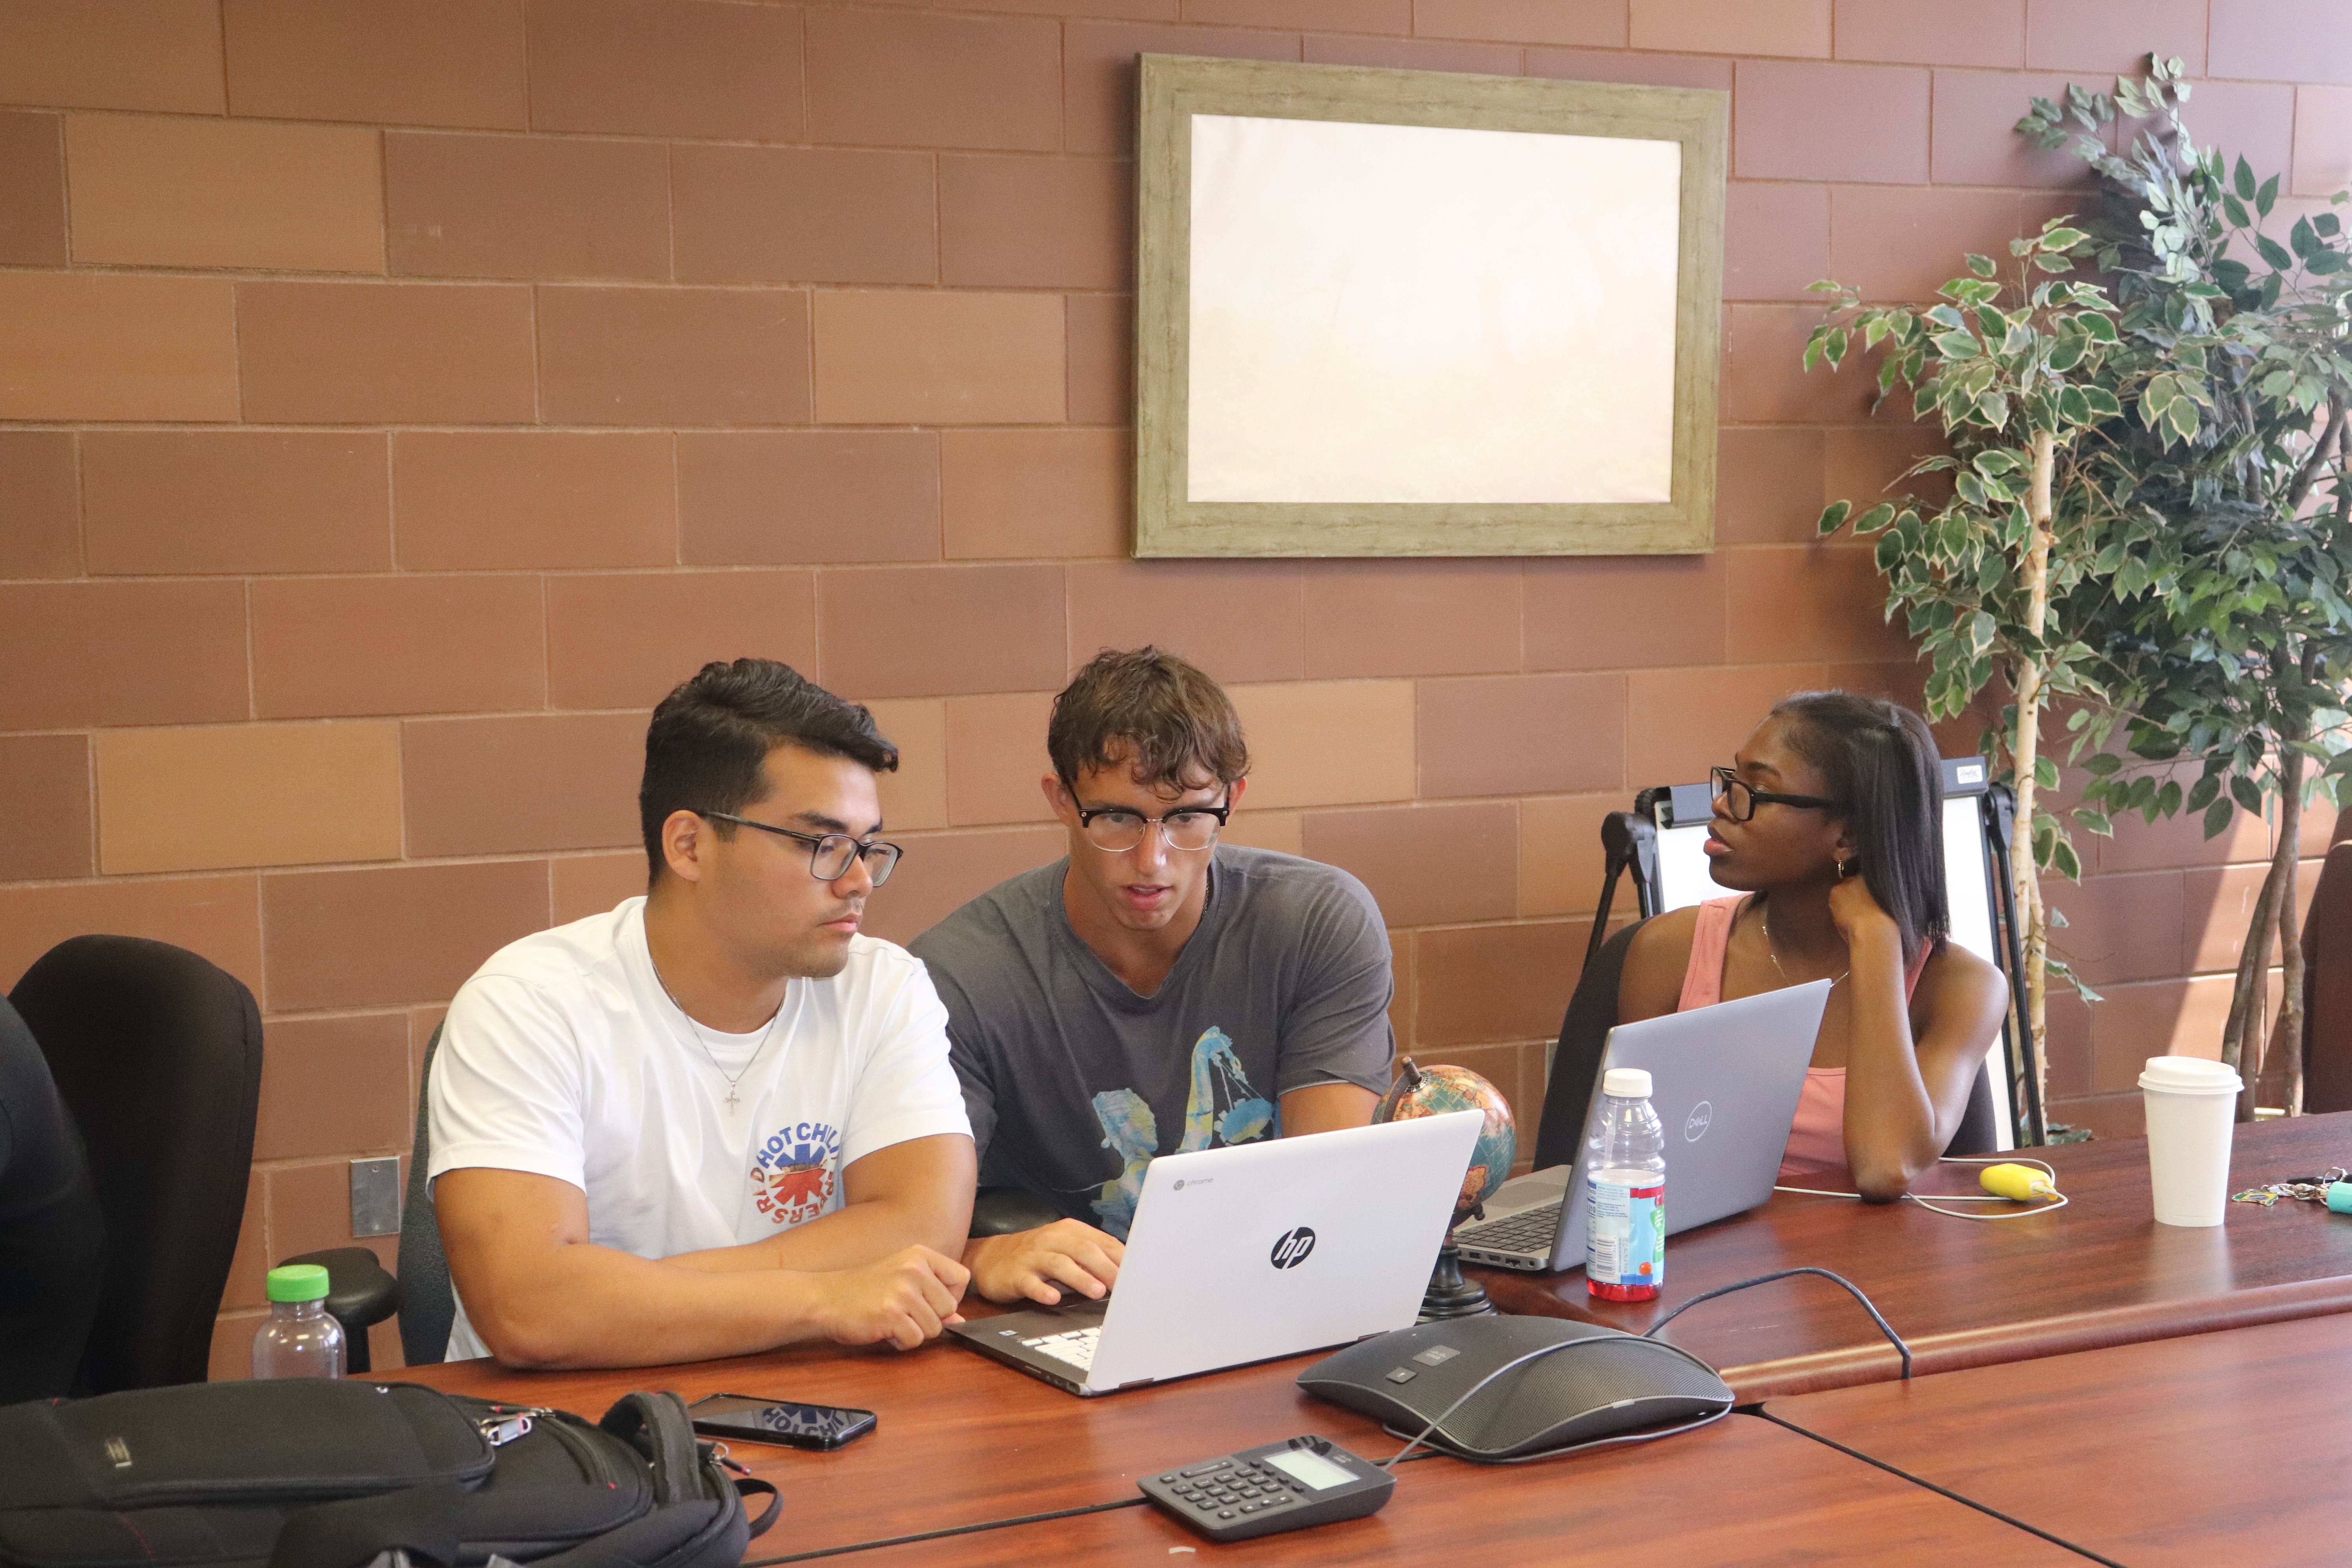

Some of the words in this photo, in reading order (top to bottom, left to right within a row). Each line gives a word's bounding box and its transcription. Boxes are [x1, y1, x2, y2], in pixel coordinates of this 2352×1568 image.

[1688, 1114, 1708, 1129] DELL
[756, 1126, 792, 1169] HOT
[1187, 1178, 1213, 1186] chrome
[1273, 1227, 1313, 1269] hp
